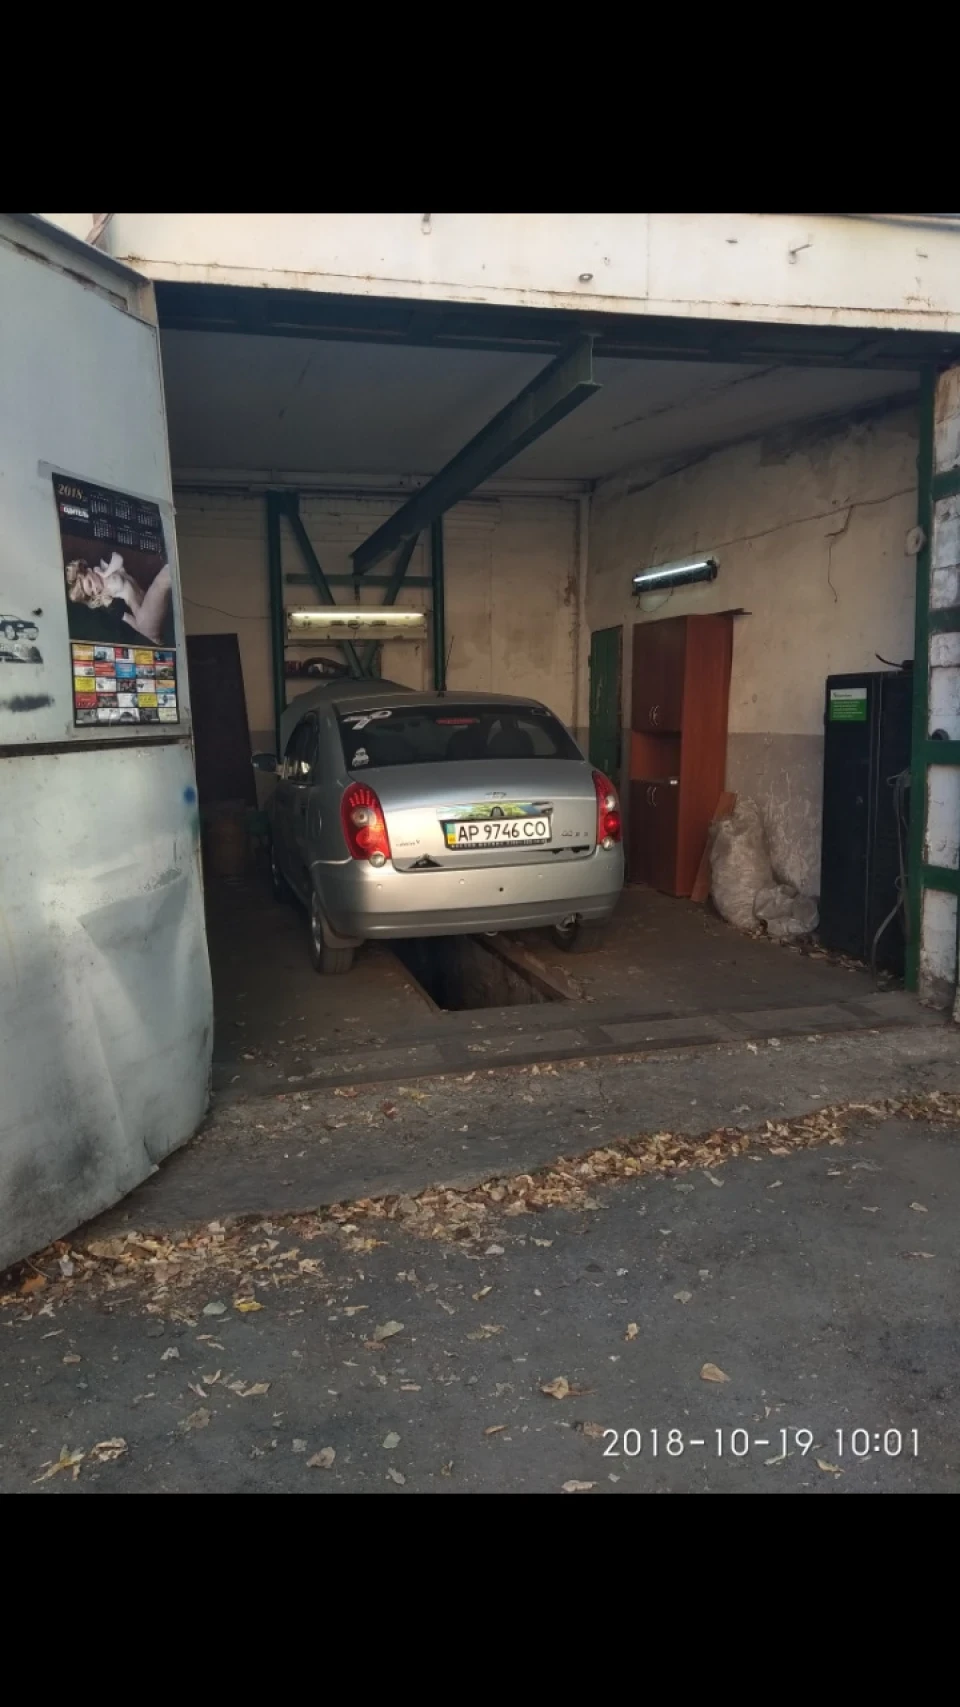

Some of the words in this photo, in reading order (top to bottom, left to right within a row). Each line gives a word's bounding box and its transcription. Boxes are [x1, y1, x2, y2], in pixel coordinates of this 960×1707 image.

[58, 484, 83, 499] 2018
[458, 825, 480, 842] AP
[484, 822, 520, 840] 9746
[523, 821, 546, 837] CO
